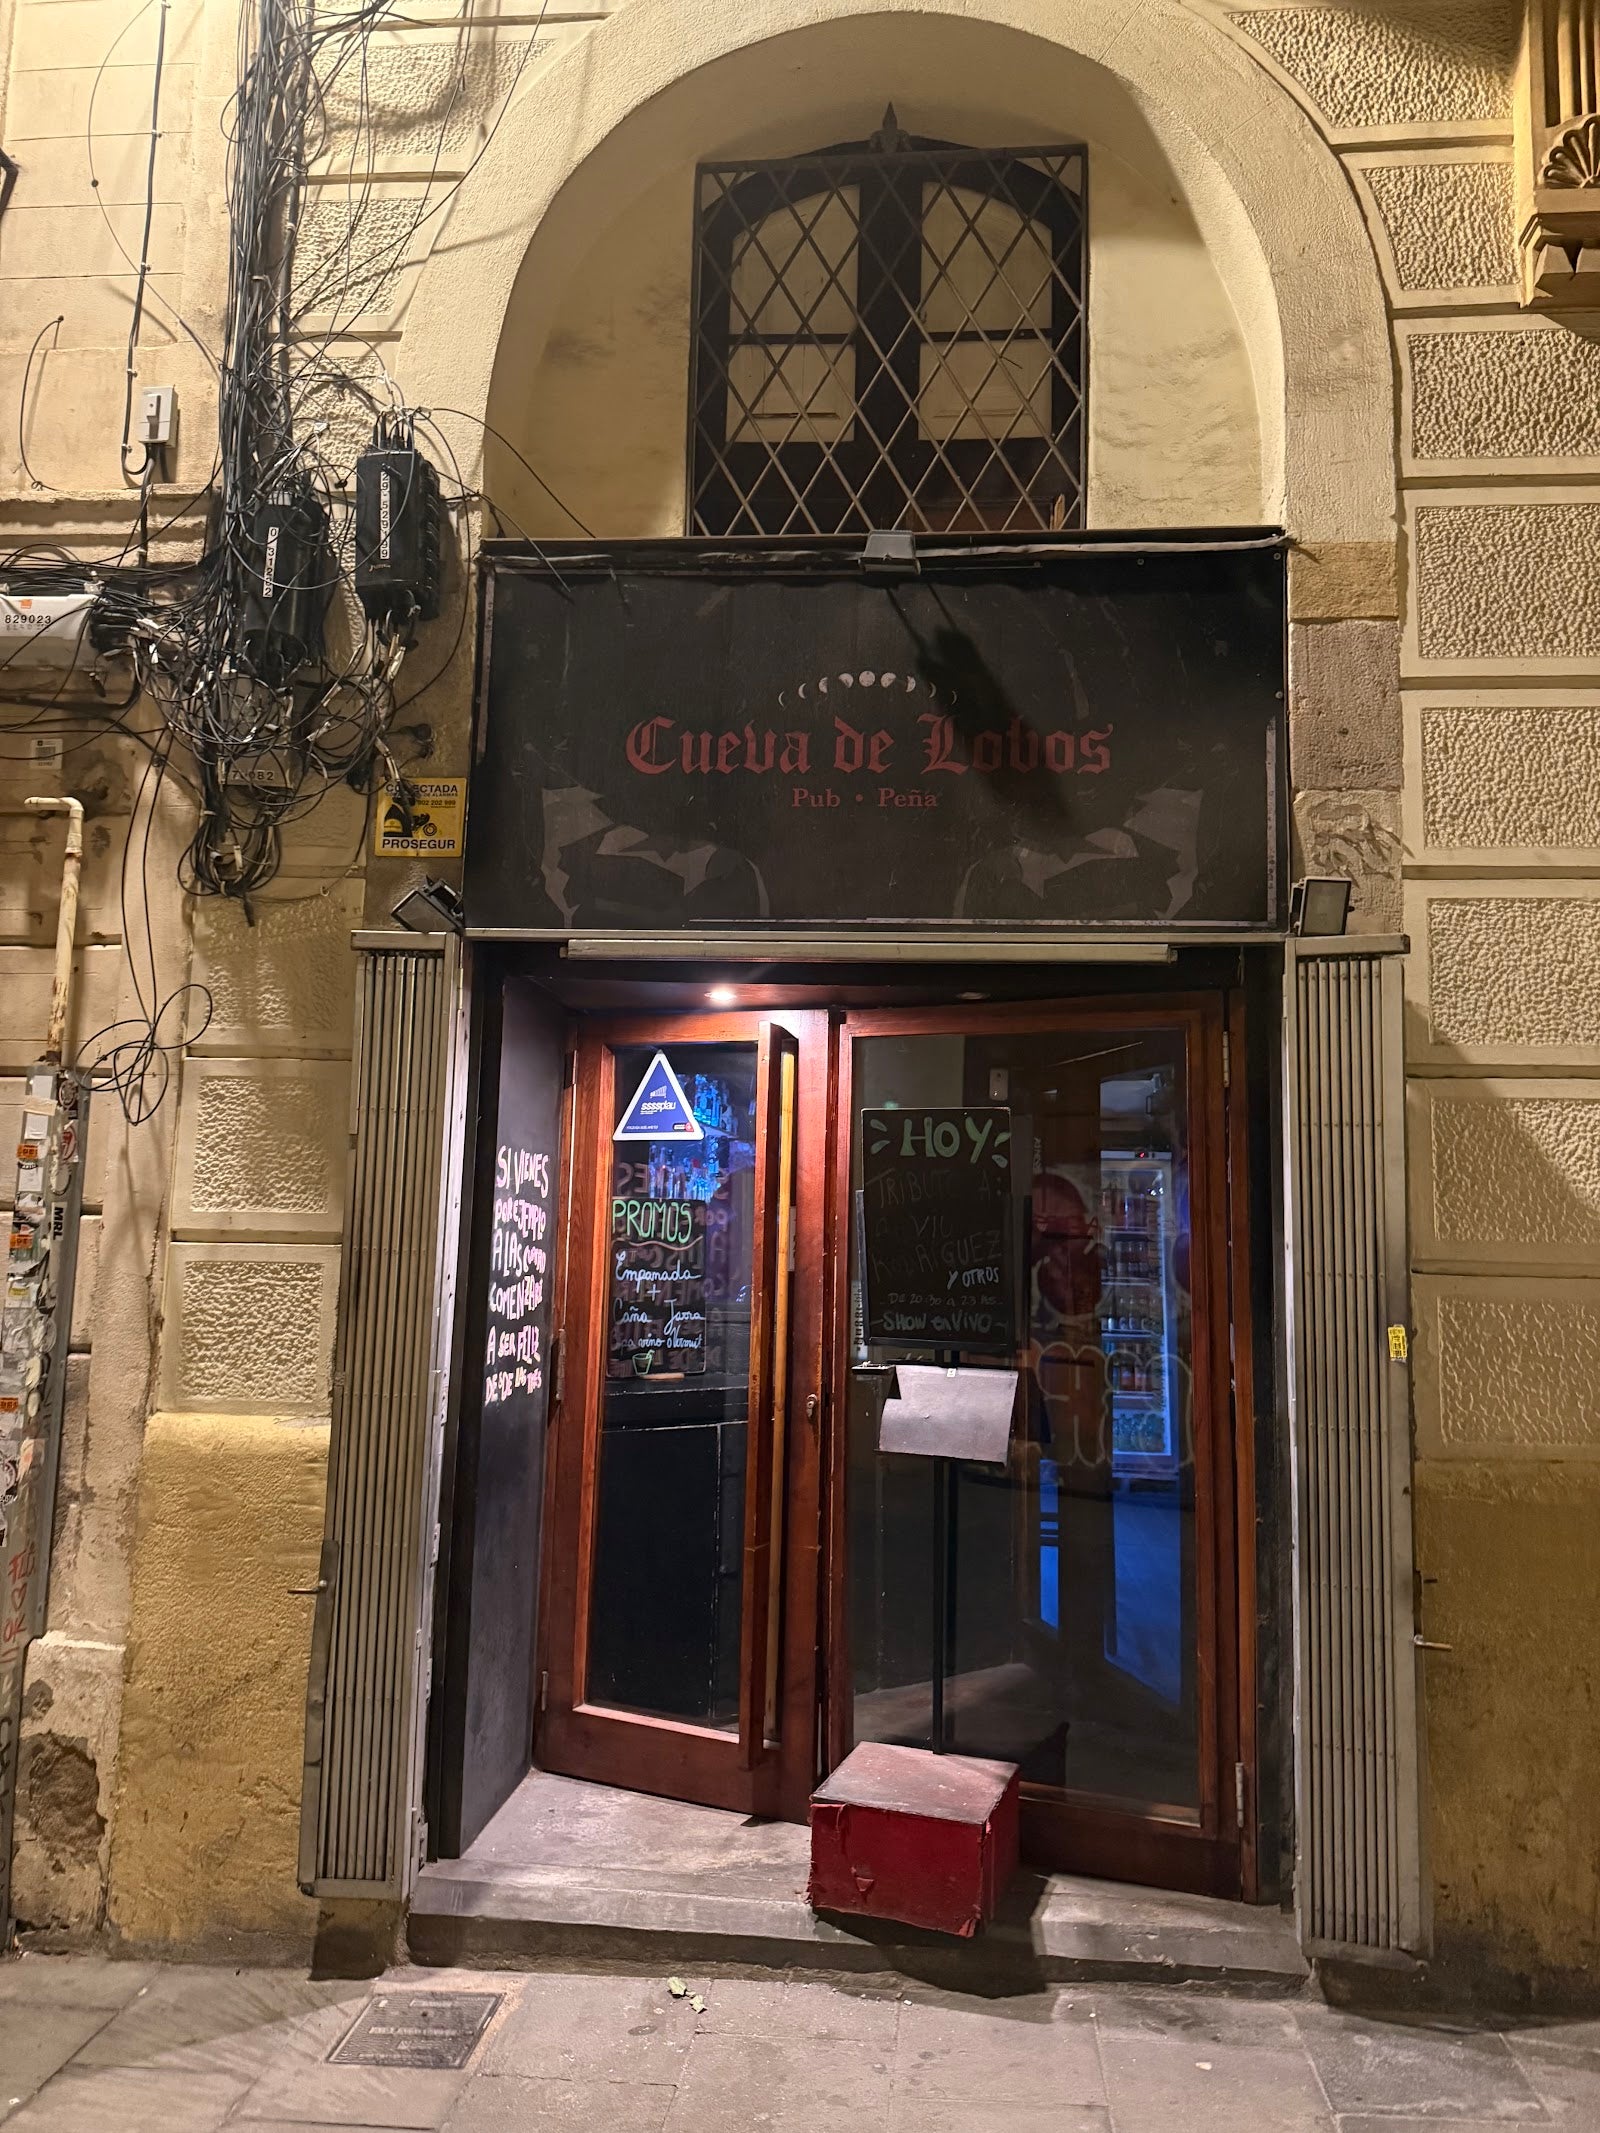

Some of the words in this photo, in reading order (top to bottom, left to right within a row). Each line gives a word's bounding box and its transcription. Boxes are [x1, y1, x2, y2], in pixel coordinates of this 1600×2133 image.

[4, 614, 52, 624] 829023
[626, 715, 812, 776] Cueva
[833, 716, 895, 775] de
[917, 713, 1114, 776] Lobos
[792, 787, 841, 808] Pub
[878, 786, 938, 808] Peña
[382, 839, 456, 850] PROSEGUR
[899, 1116, 993, 1164] HOY
[496, 1145, 512, 1189] SI
[514, 1148, 549, 1199] VIENES
[865, 1166, 959, 1209] TRIBUT
[53, 1206, 64, 1241] MRL
[611, 1199, 692, 1244] PROMOS
[492, 1228, 503, 1271] A
[503, 1230, 522, 1278] LAS
[614, 1250, 702, 1293] Empanada
[962, 1266, 1000, 1288] OTROS
[613, 1297, 652, 1325] Caña
[663, 1299, 706, 1336] Jarra
[883, 1309, 927, 1332] SHOW
[486, 1325, 496, 1365] A
[638, 1333, 666, 1349] vino
